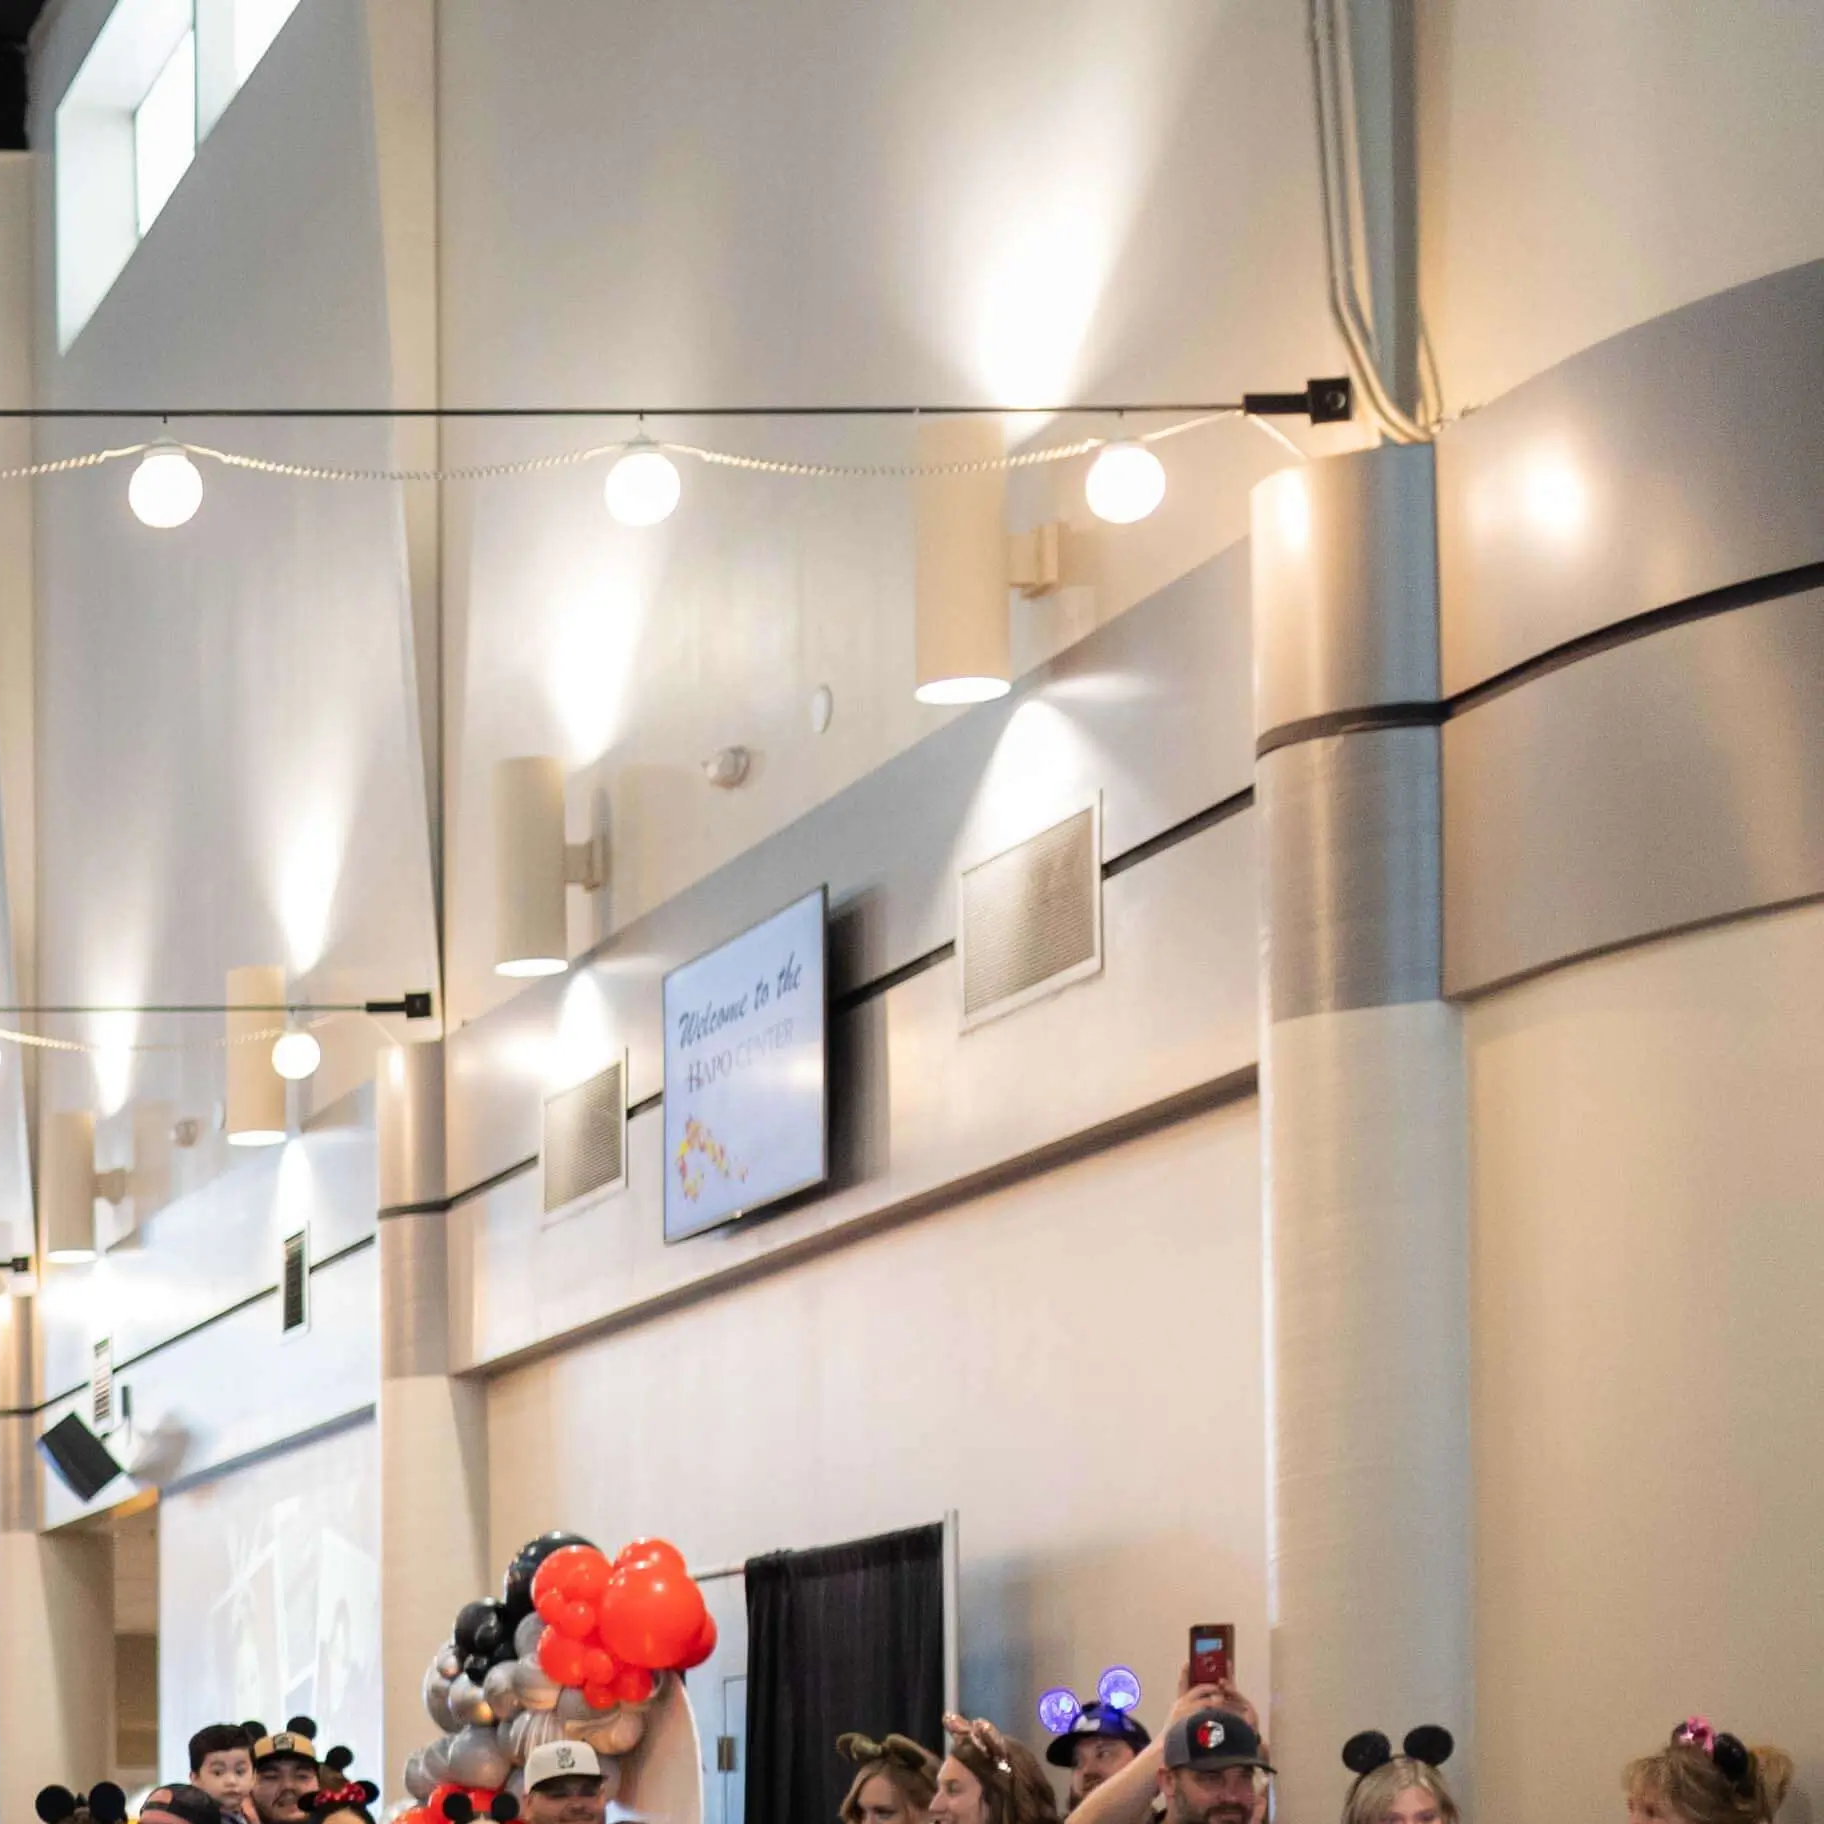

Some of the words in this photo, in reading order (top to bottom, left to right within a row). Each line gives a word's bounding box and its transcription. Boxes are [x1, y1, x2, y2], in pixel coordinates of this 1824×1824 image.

[678, 993, 748, 1050] Welcome
[754, 974, 770, 1012] to
[776, 951, 802, 1000] the
